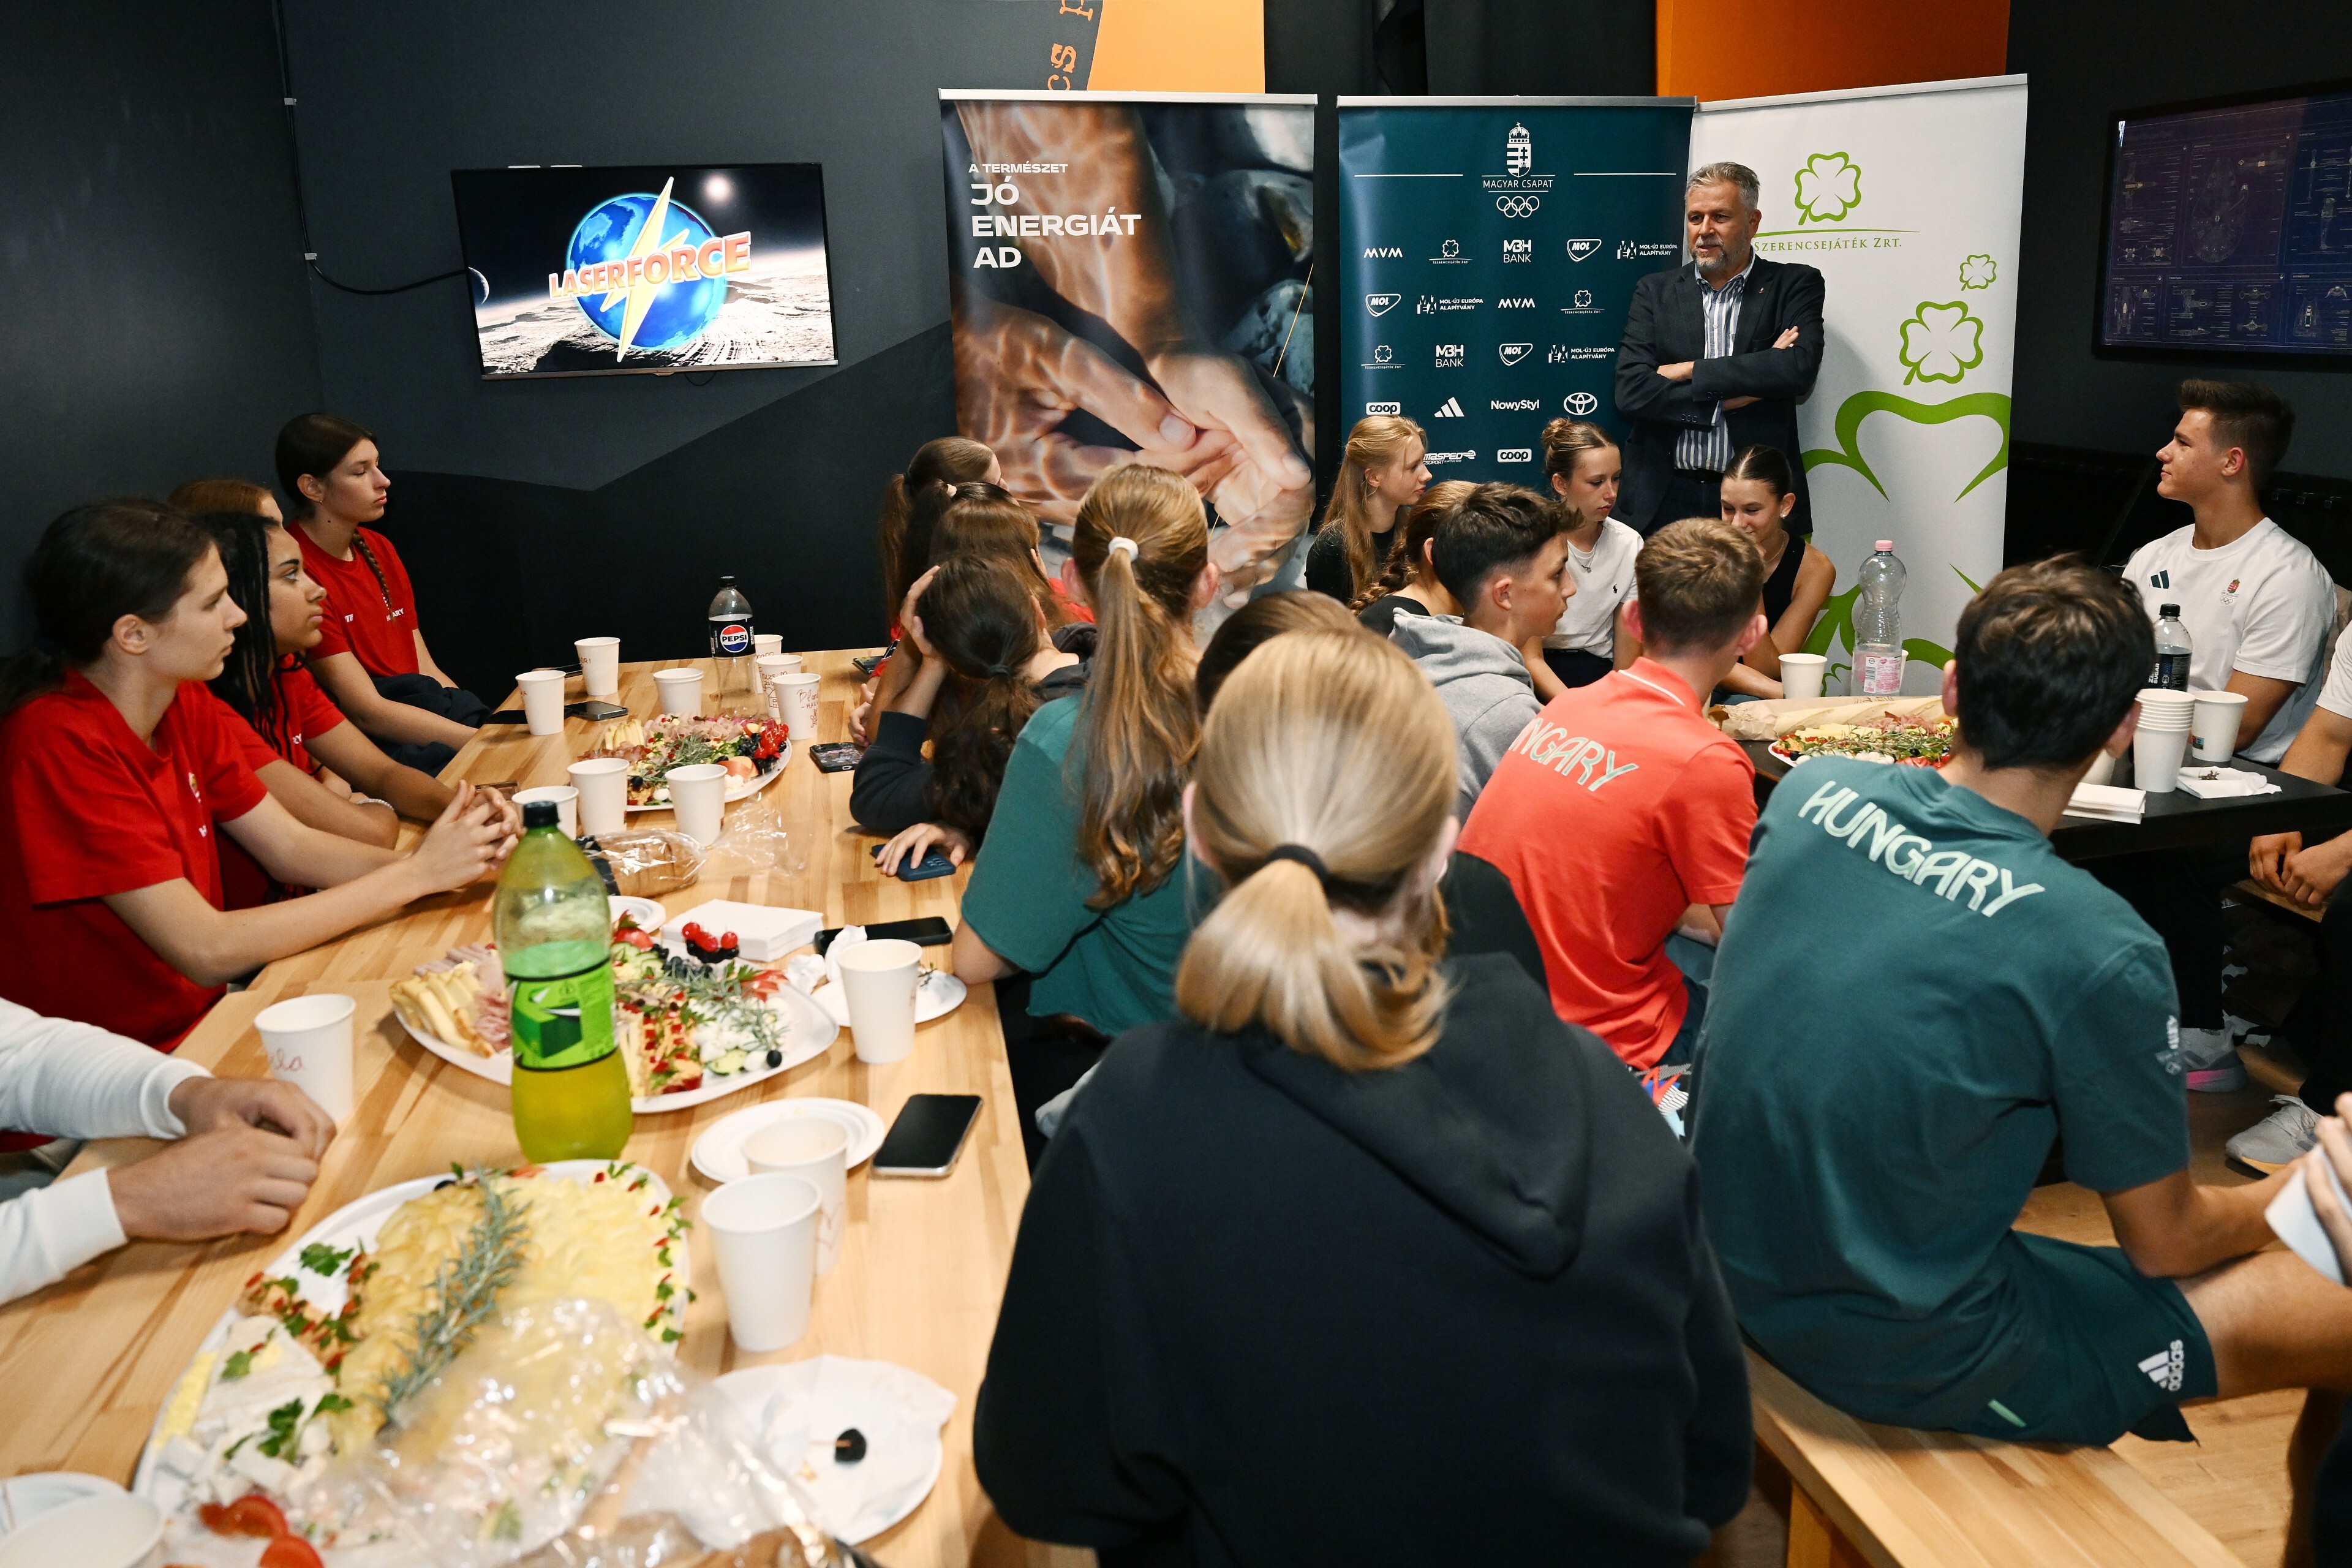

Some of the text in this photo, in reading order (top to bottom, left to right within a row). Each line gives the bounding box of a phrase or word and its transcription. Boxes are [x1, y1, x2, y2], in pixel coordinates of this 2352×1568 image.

[968, 160, 1068, 173] A TERMÉSZET
[1483, 179, 1553, 188] MAGYAR CSAPAT
[971, 176, 1019, 205] JÓ
[972, 207, 1141, 236] ENERGIÁT
[1503, 239, 1531, 252] MBH
[1572, 242, 1590, 251] MOL
[1754, 238, 1902, 252] SZERENCSEJÁTÉK ZRT.
[973, 247, 1021, 268] AD
[1363, 247, 1403, 258] MVM
[1503, 254, 1531, 263] BANK
[549, 232, 752, 300] LASERFORCE
[1370, 297, 1389, 306] MOL
[1498, 298, 1536, 309] MVM
[1436, 344, 1464, 357] MBH
[1504, 346, 1522, 355] MOL
[1436, 358, 1464, 368] BANK
[1369, 404, 1398, 414] coop
[1491, 399, 1540, 411] NowyStyl
[1500, 451, 1529, 461] coop
[1798, 780, 2045, 918] HUNGARY
[2168, 1339, 2185, 1392] adidas
